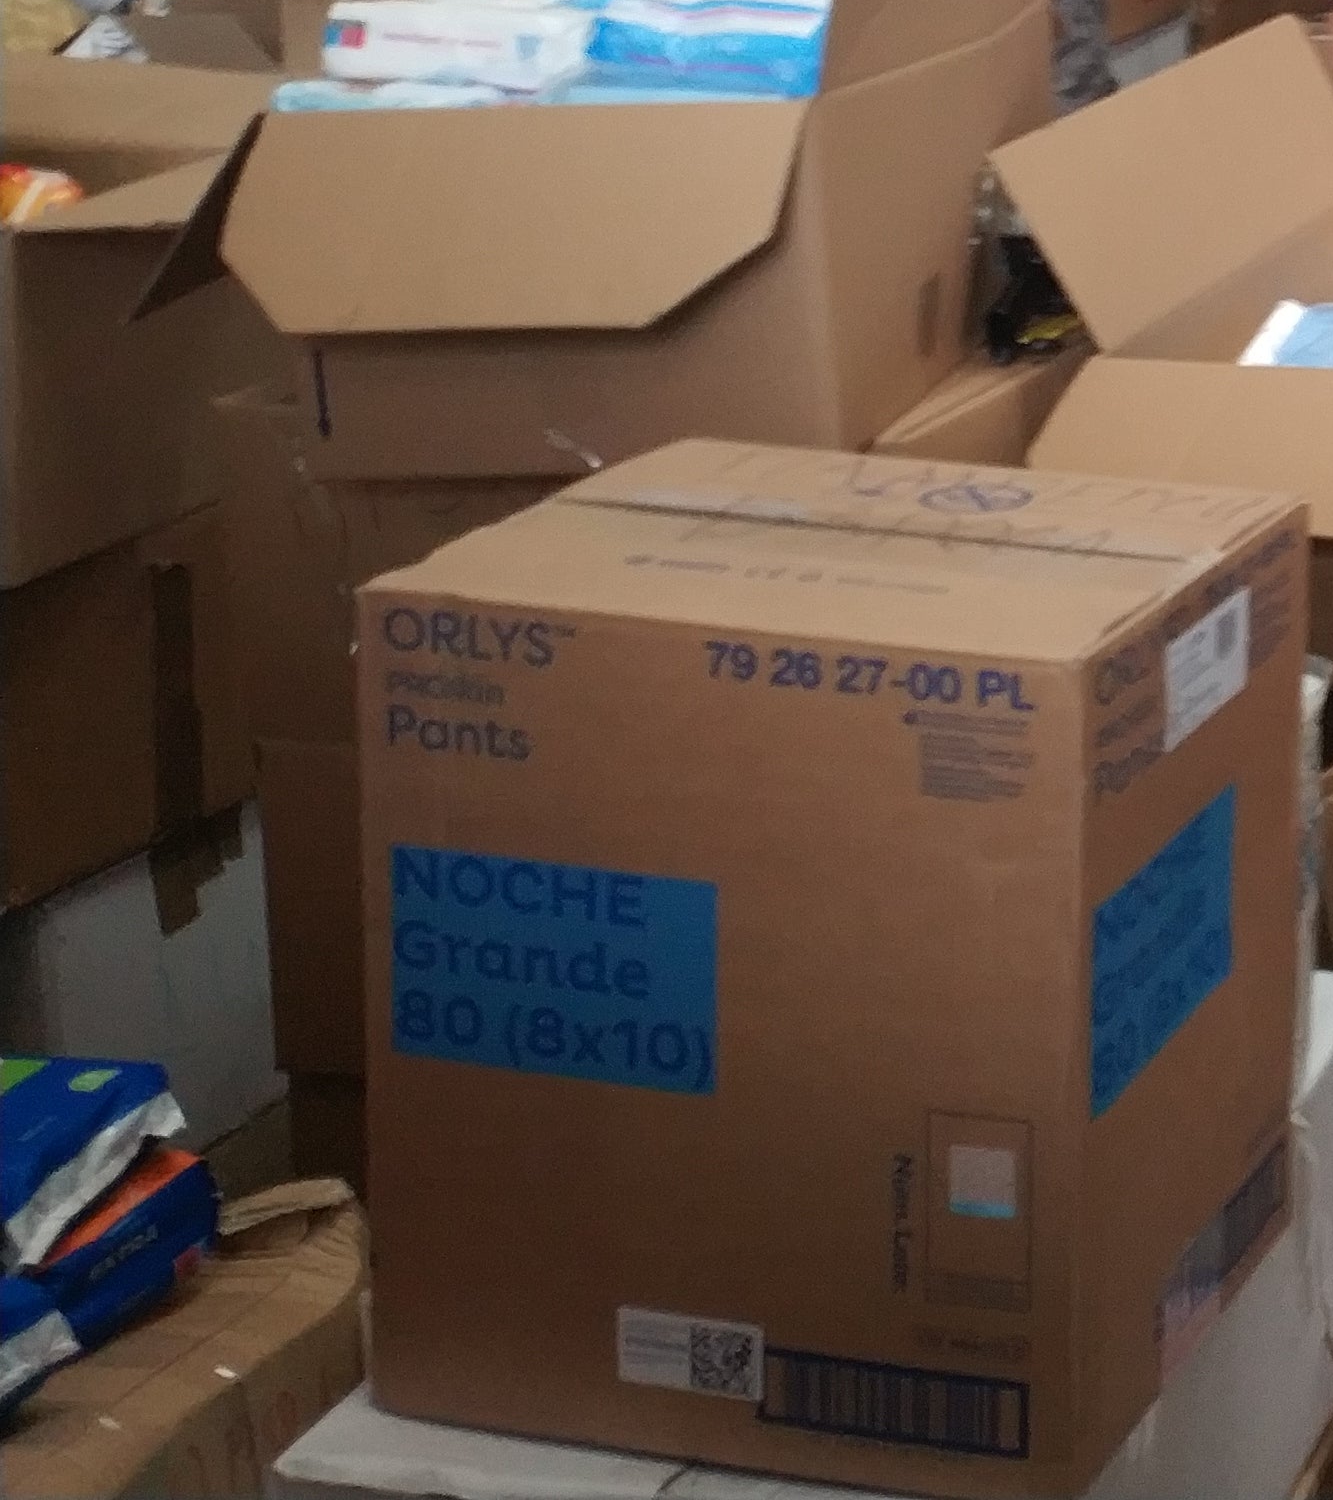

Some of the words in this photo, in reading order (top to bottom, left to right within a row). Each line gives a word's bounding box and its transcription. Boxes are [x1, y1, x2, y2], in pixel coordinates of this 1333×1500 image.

[705, 639, 758, 682] 79
[834, 655, 964, 705] 27-00
[974, 668, 1035, 713] PL
[387, 704, 533, 762] Pants
[400, 848, 645, 928] NOCHE
[398, 919, 649, 1000] Grande
[400, 988, 482, 1046] 80
[506, 1003, 713, 1092] (8x10)
